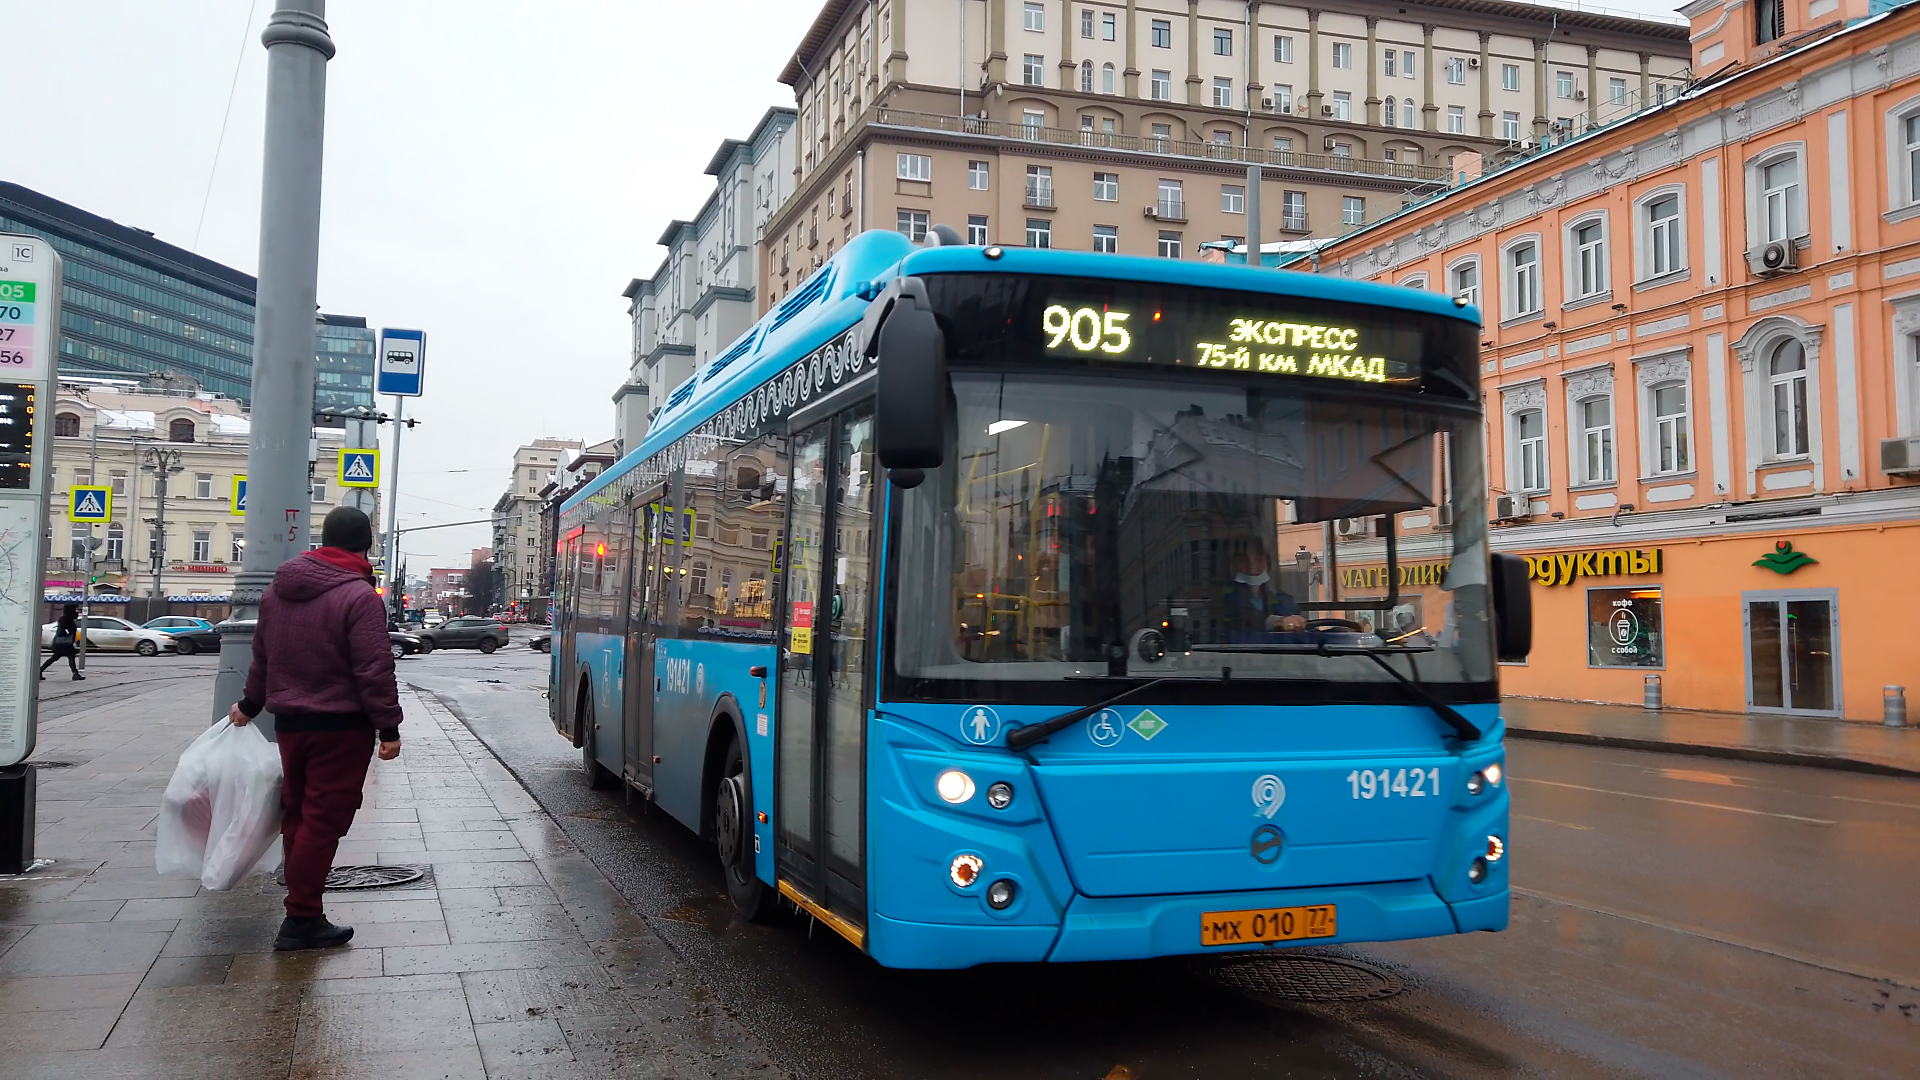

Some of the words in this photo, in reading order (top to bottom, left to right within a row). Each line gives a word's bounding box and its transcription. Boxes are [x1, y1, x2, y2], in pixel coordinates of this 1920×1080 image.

[1043, 304, 1131, 354] 905
[1229, 318, 1358, 351] ЭКСПРЕСС
[1197, 342, 1250, 370] 75-й
[1258, 352, 1298, 373] км
[1306, 352, 1386, 383] МКАД
[288, 526, 298, 541] 5
[1524, 549, 1660, 587] одукты
[1612, 598, 1633, 608] кофе
[1616, 646, 1638, 654] собой
[666, 657, 691, 694] 191421
[1346, 767, 1440, 800] 191421
[1252, 911, 1295, 938] 010
[1308, 907, 1328, 927] 77
